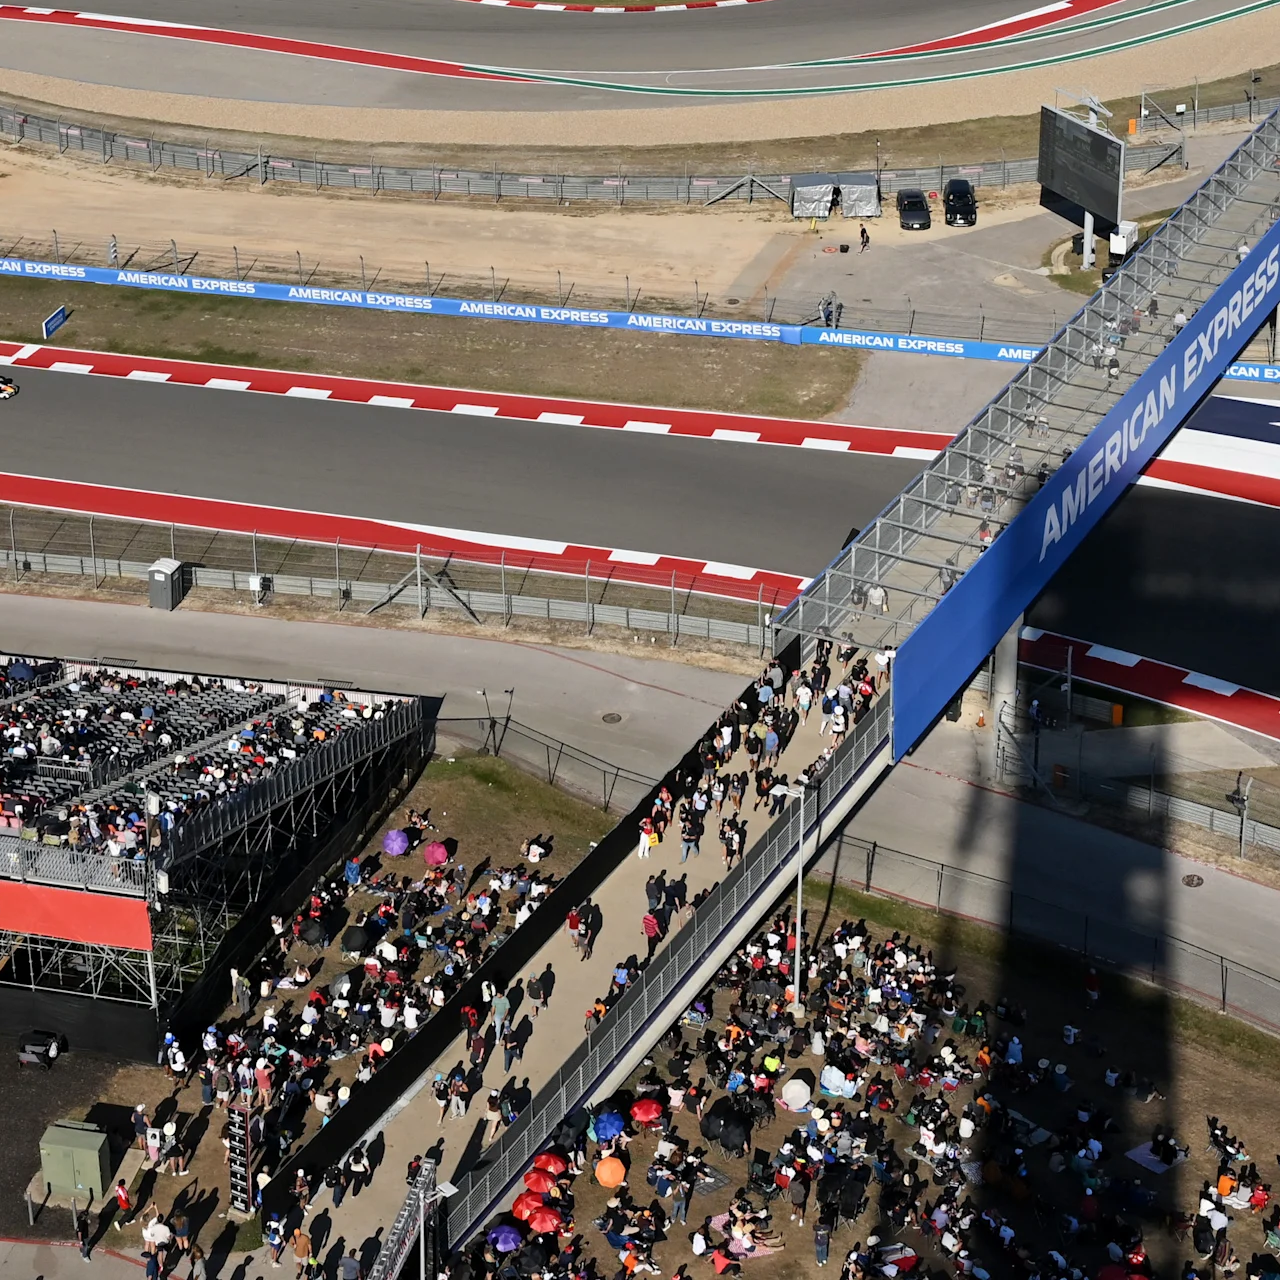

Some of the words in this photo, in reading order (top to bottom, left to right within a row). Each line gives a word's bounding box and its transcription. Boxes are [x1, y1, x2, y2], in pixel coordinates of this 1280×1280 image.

[25, 263, 85, 277] EXPRESS
[118, 272, 188, 287] AMERICAN
[192, 279, 255, 293] EXPRESS
[289, 288, 362, 302] AMERICAN
[367, 294, 432, 309] EXPRESS
[460, 303, 536, 317] AMERICAN
[541, 309, 608, 323] EXPRESS
[628, 315, 706, 333] AMERICAN
[712, 322, 780, 336] EXPRESS
[820, 332, 893, 347] AMERICAN
[899, 338, 963, 353] EXPRESS
[997, 347, 1039, 361] AMER
[1226, 365, 1260, 378] ICAN
[1039, 365, 1177, 563] AMERICAN
[1182, 244, 1280, 391] EXPRESS
